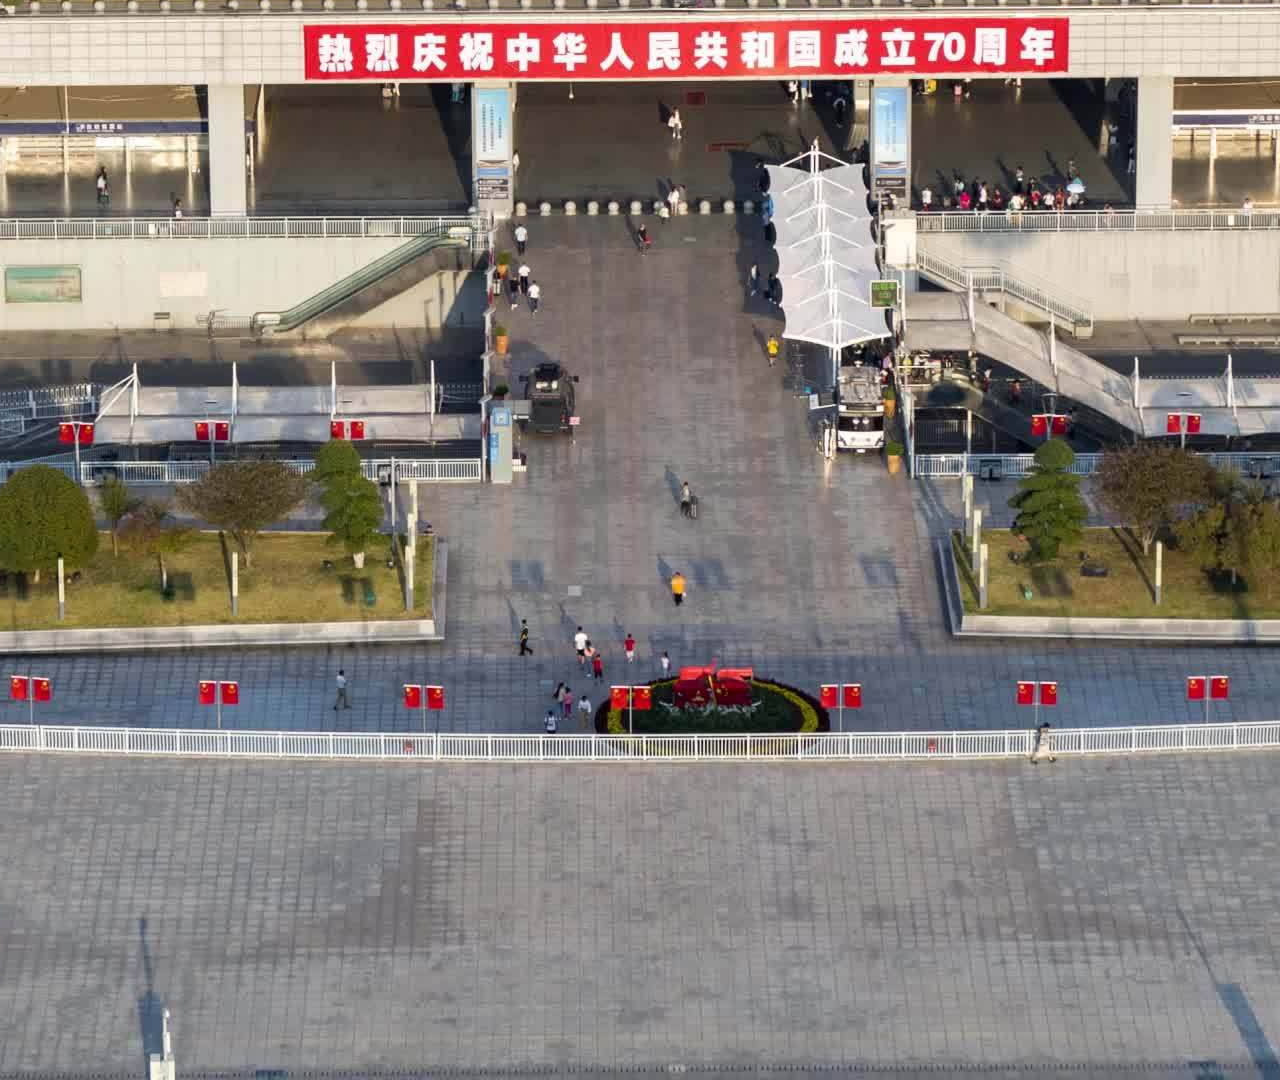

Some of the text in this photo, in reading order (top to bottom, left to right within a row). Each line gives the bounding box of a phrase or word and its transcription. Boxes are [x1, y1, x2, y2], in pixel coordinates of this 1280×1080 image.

[318, 28, 1055, 73] 热烈庆祝中华人民共和国成立70周年
